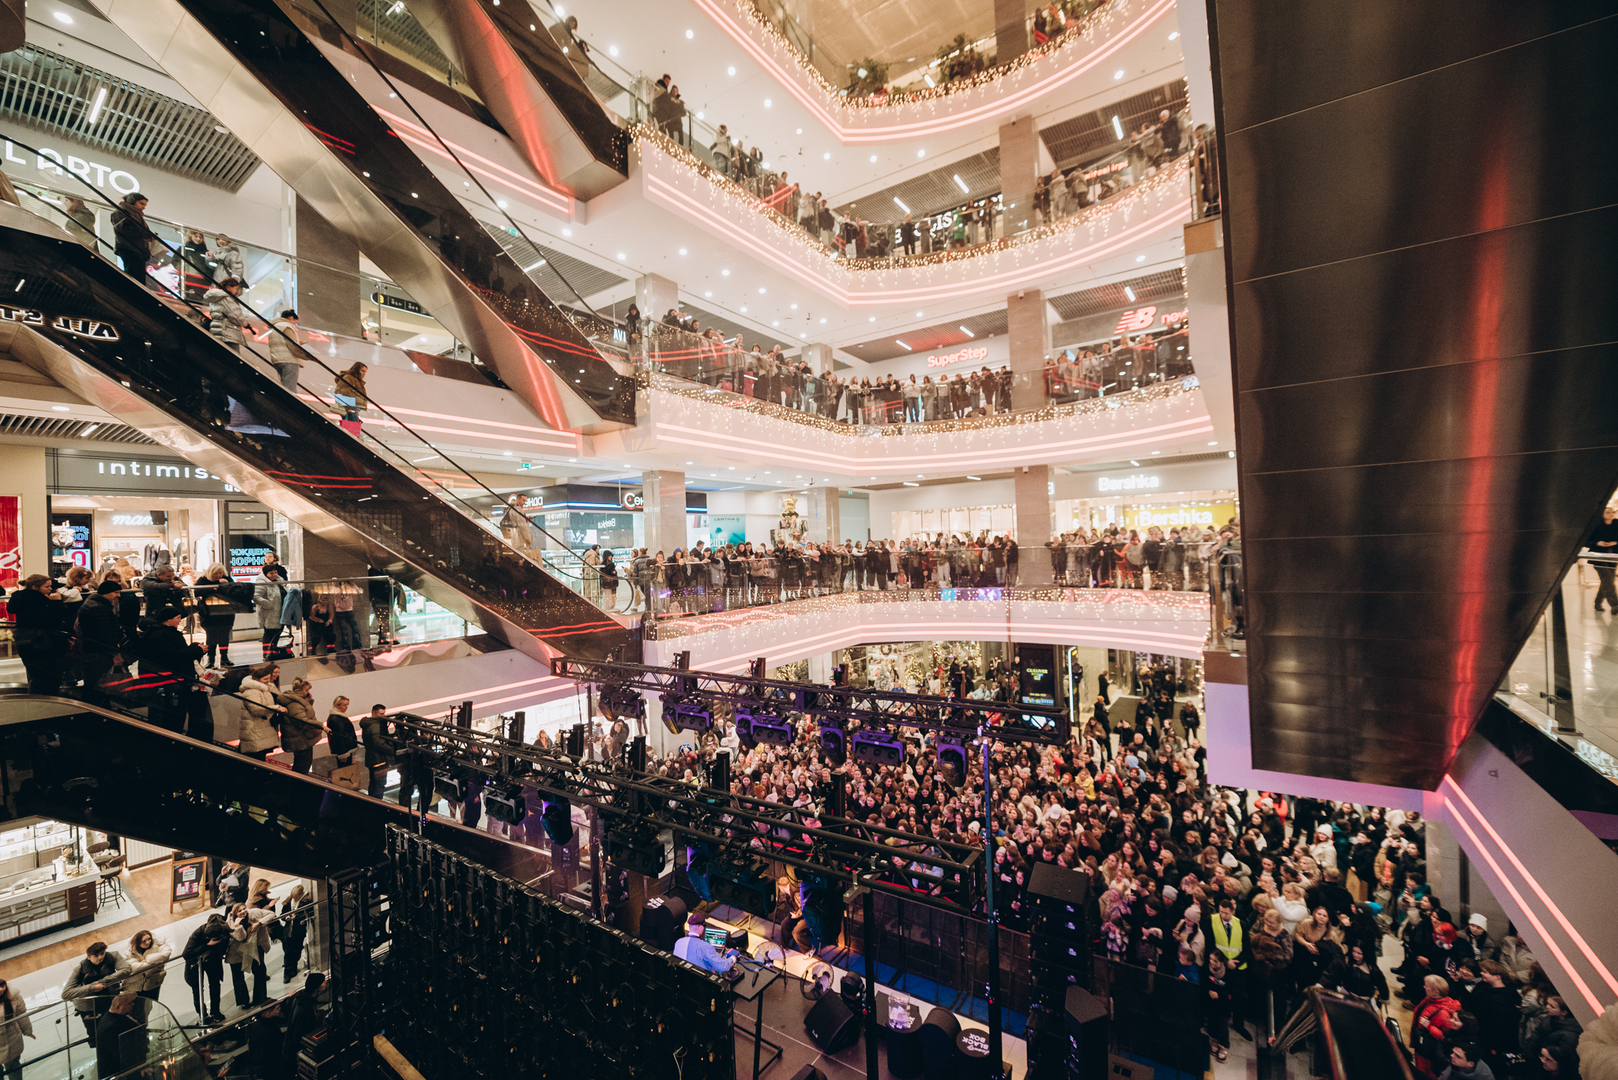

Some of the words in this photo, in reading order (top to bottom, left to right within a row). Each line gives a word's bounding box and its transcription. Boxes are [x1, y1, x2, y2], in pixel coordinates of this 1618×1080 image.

[37, 147, 140, 195] ARTO
[926, 346, 989, 368] SuperStep
[98, 461, 222, 480] intimis
[1098, 474, 1160, 492] Bershka
[1139, 509, 1214, 528] Bershka
